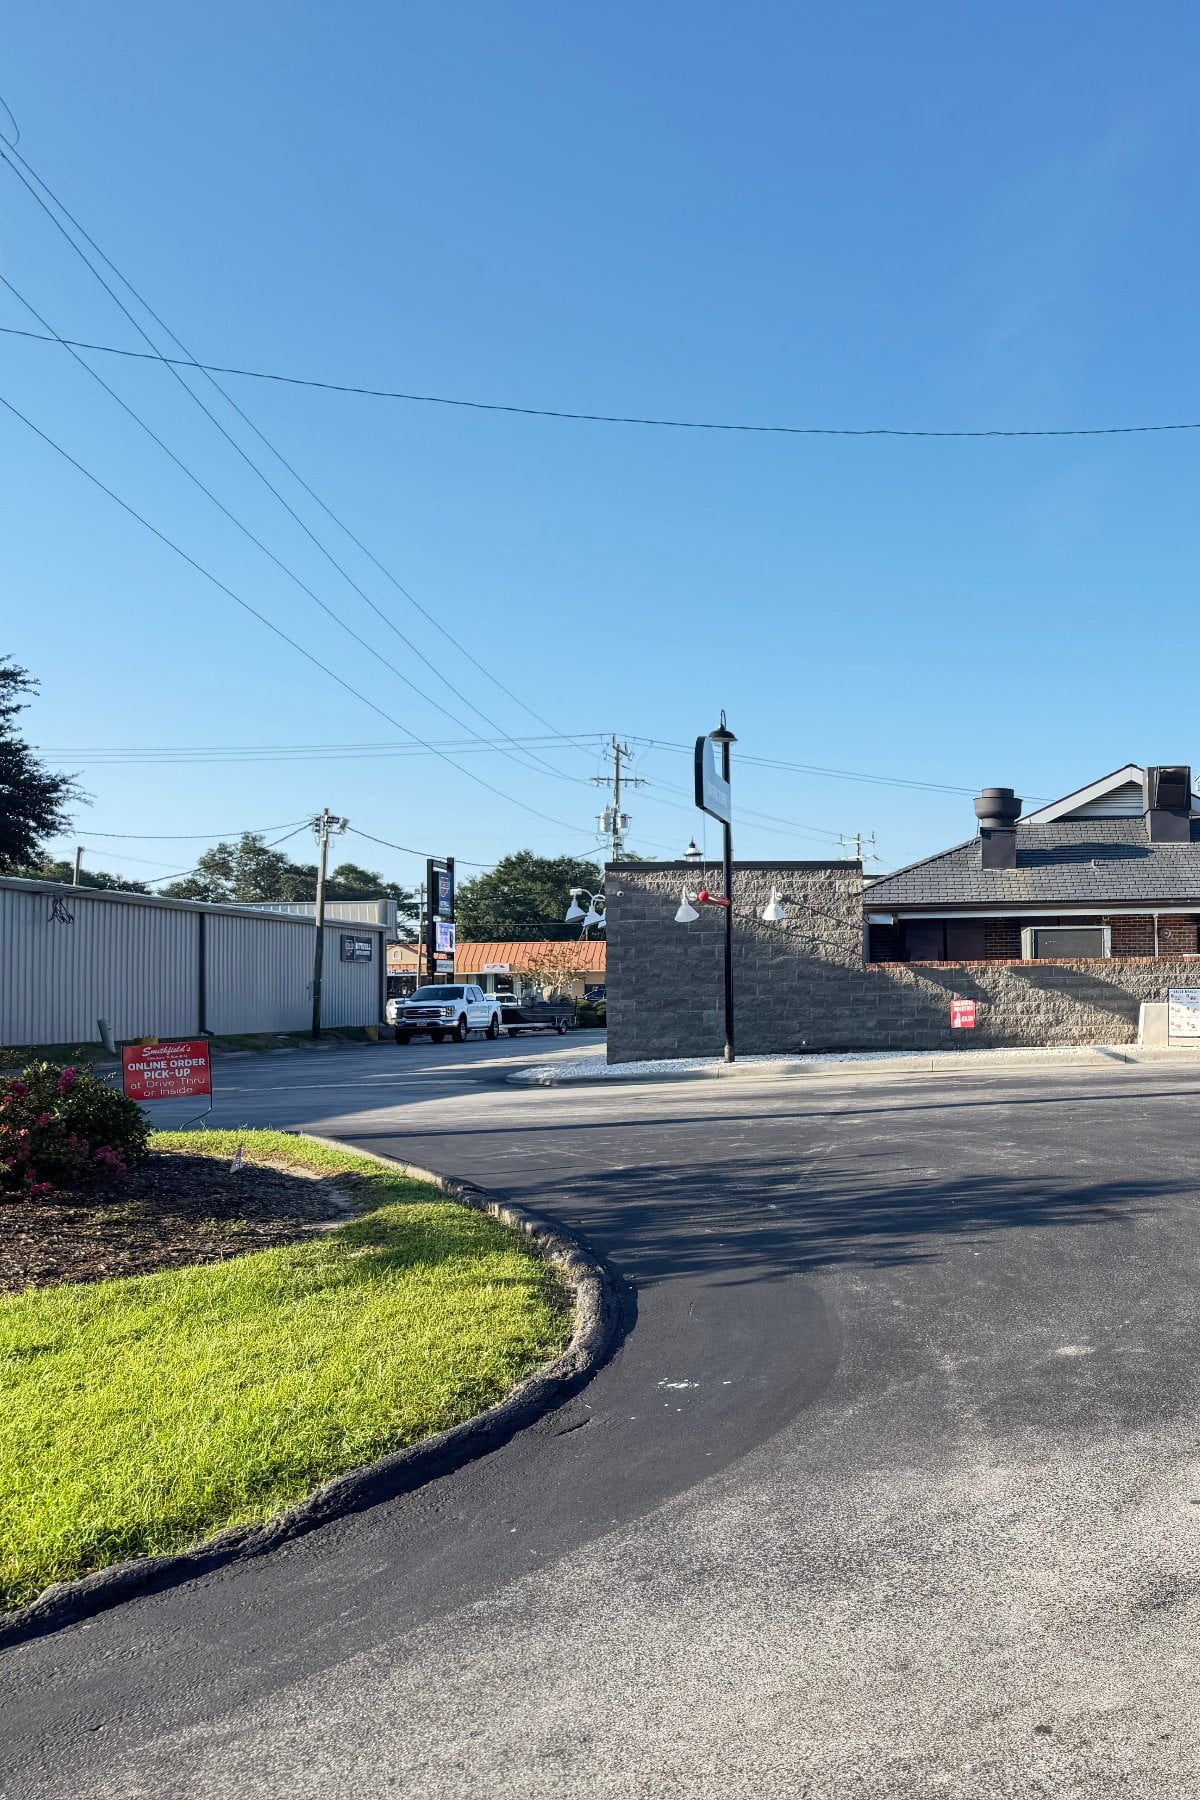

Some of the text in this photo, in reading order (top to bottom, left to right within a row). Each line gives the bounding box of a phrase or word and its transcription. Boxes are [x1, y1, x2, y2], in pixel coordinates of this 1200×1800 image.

[141, 1044, 191, 1057] Smithfield's
[127, 1058, 206, 1071] ONLINE ORDER
[144, 1068, 191, 1080] PICK-UP
[130, 1082, 141, 1090] at
[160, 1086, 193, 1096] Inside
